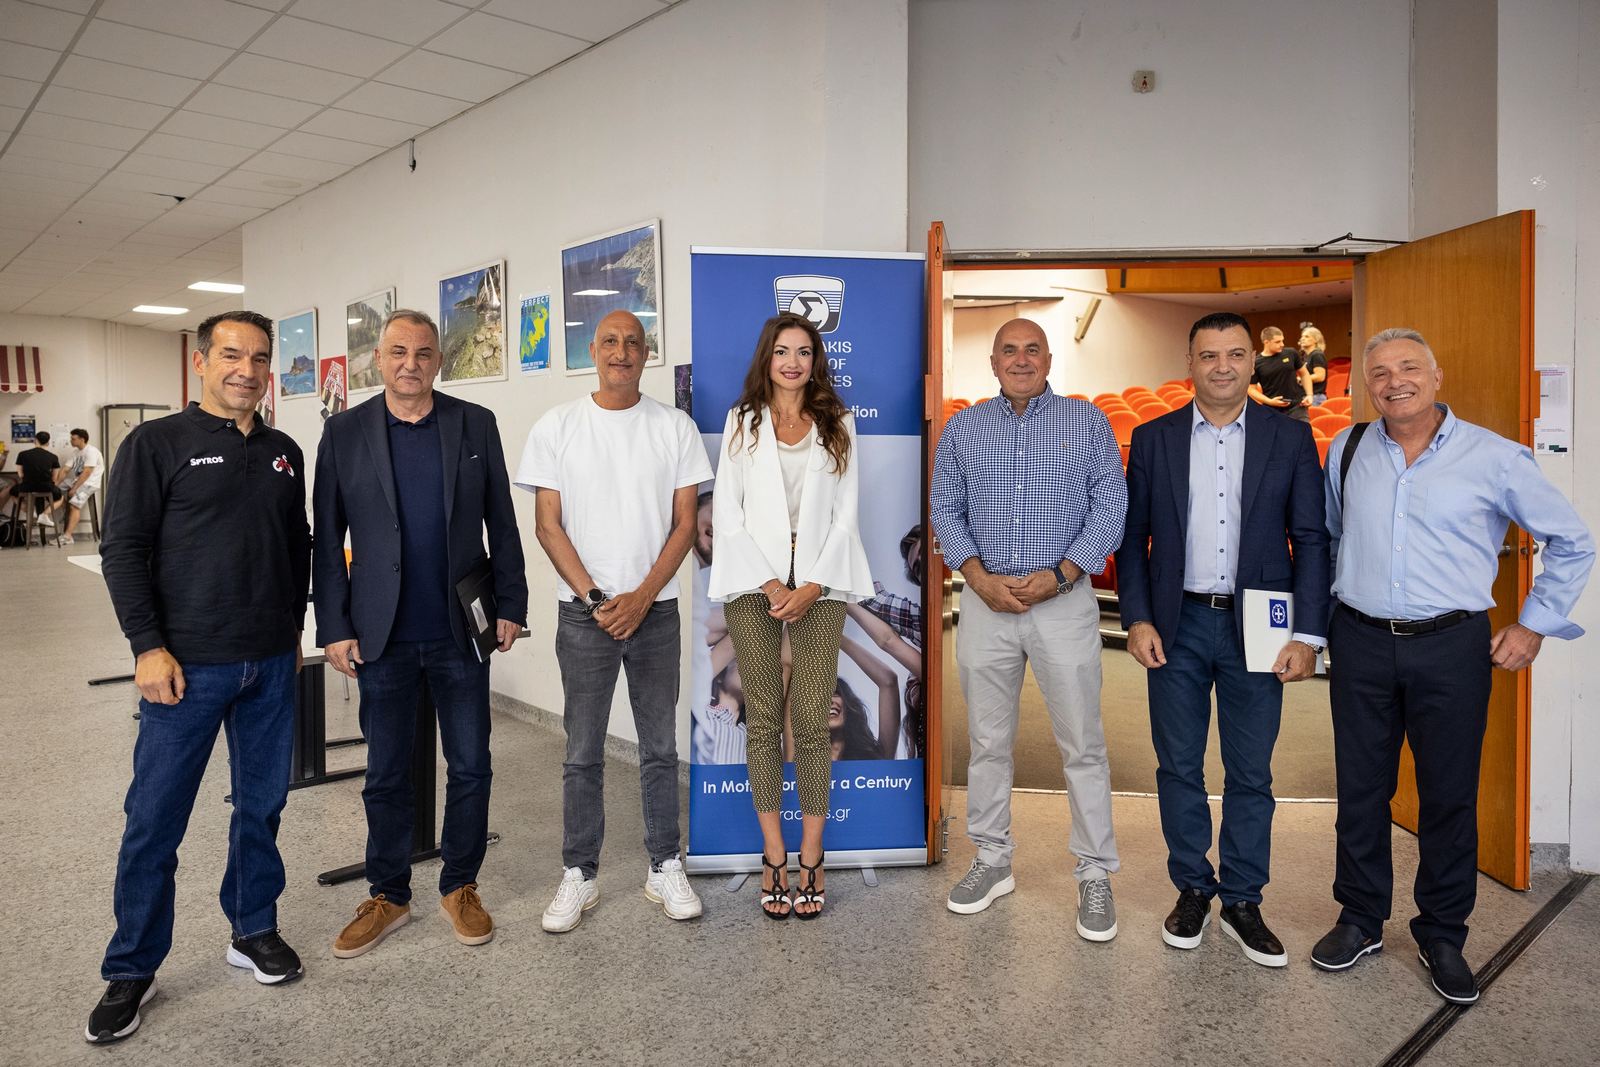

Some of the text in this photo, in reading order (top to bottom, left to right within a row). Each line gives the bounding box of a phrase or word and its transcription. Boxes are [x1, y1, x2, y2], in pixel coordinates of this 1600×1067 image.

[521, 297, 549, 307] PERFECT
[828, 358, 847, 370] OF
[845, 405, 878, 418] tion
[703, 781, 717, 794] In
[782, 781, 796, 791] or
[840, 779, 850, 789] a
[855, 776, 912, 791] Century
